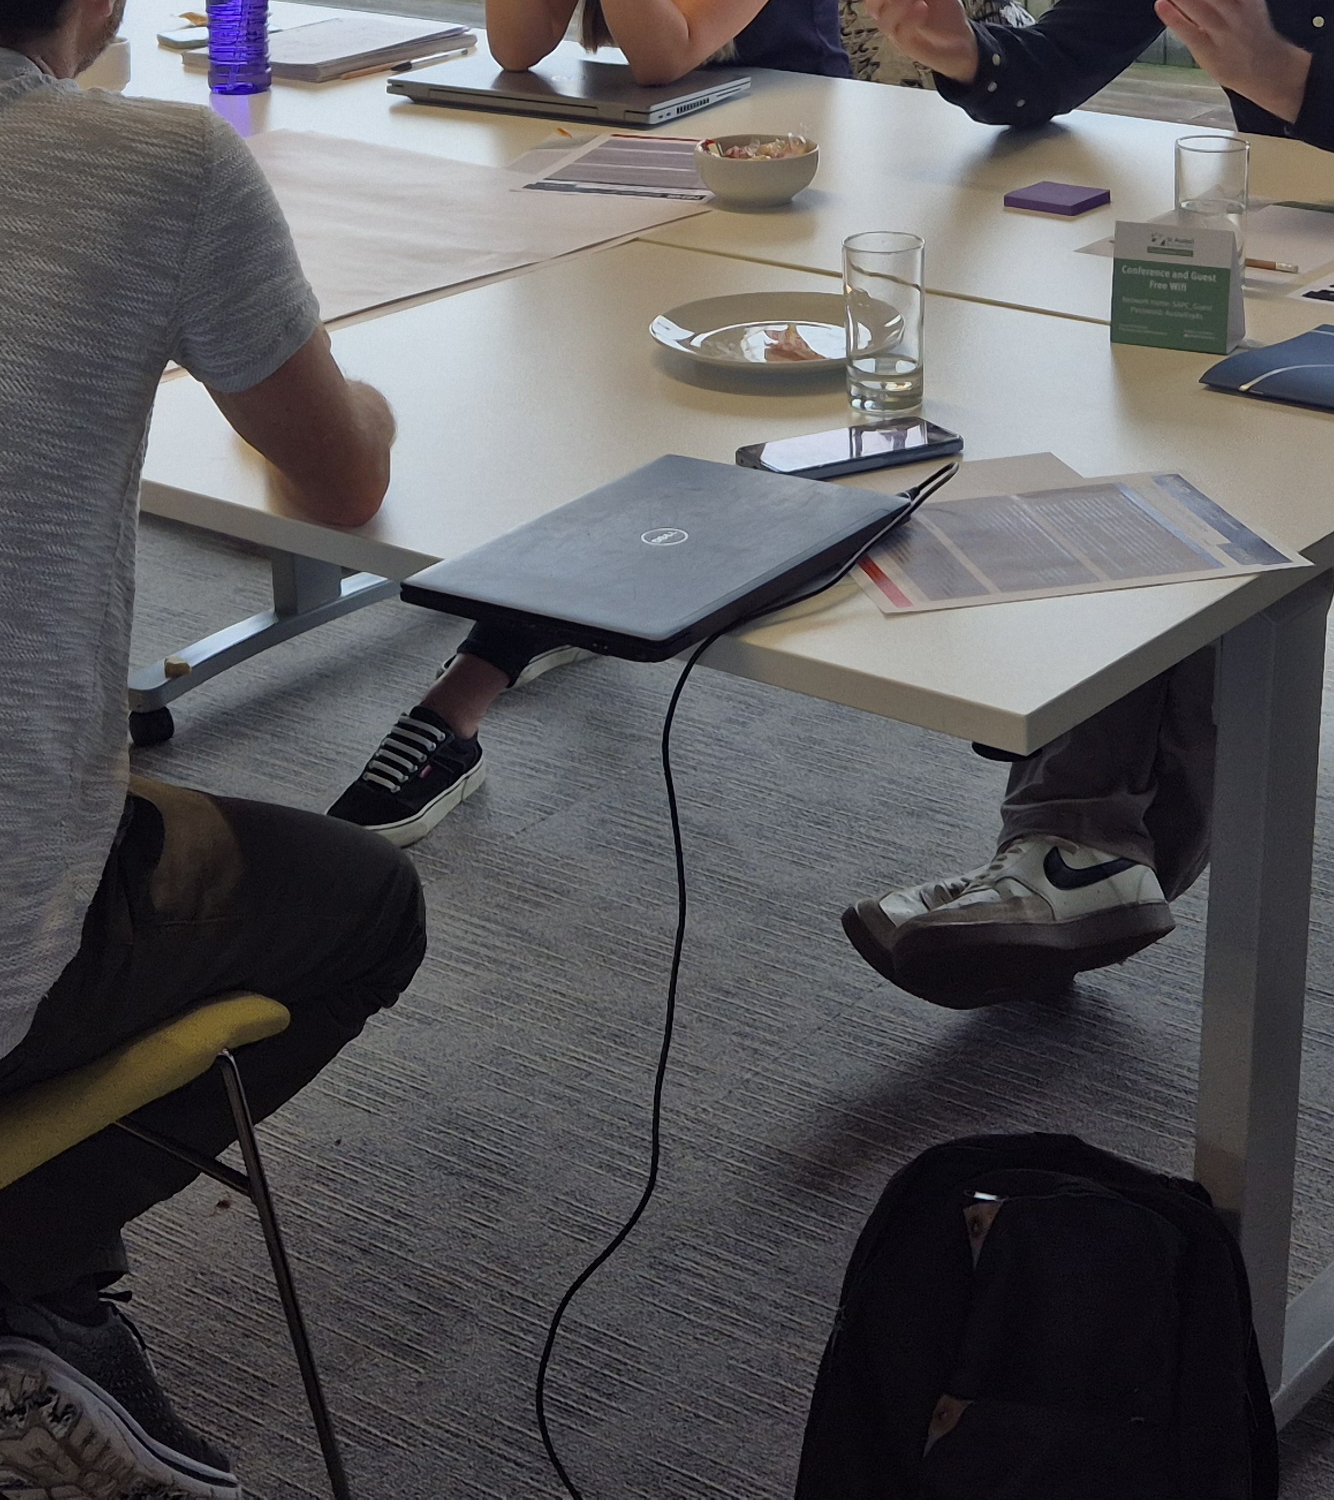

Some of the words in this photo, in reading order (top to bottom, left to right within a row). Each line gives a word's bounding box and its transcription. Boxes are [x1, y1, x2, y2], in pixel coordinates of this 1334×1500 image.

[1121, 265, 1170, 278] Conference
[1172, 269, 1189, 279] and
[1190, 271, 1216, 282] Guest
[1149, 280, 1167, 290] Free
[1169, 281, 1187, 292] Wifi
